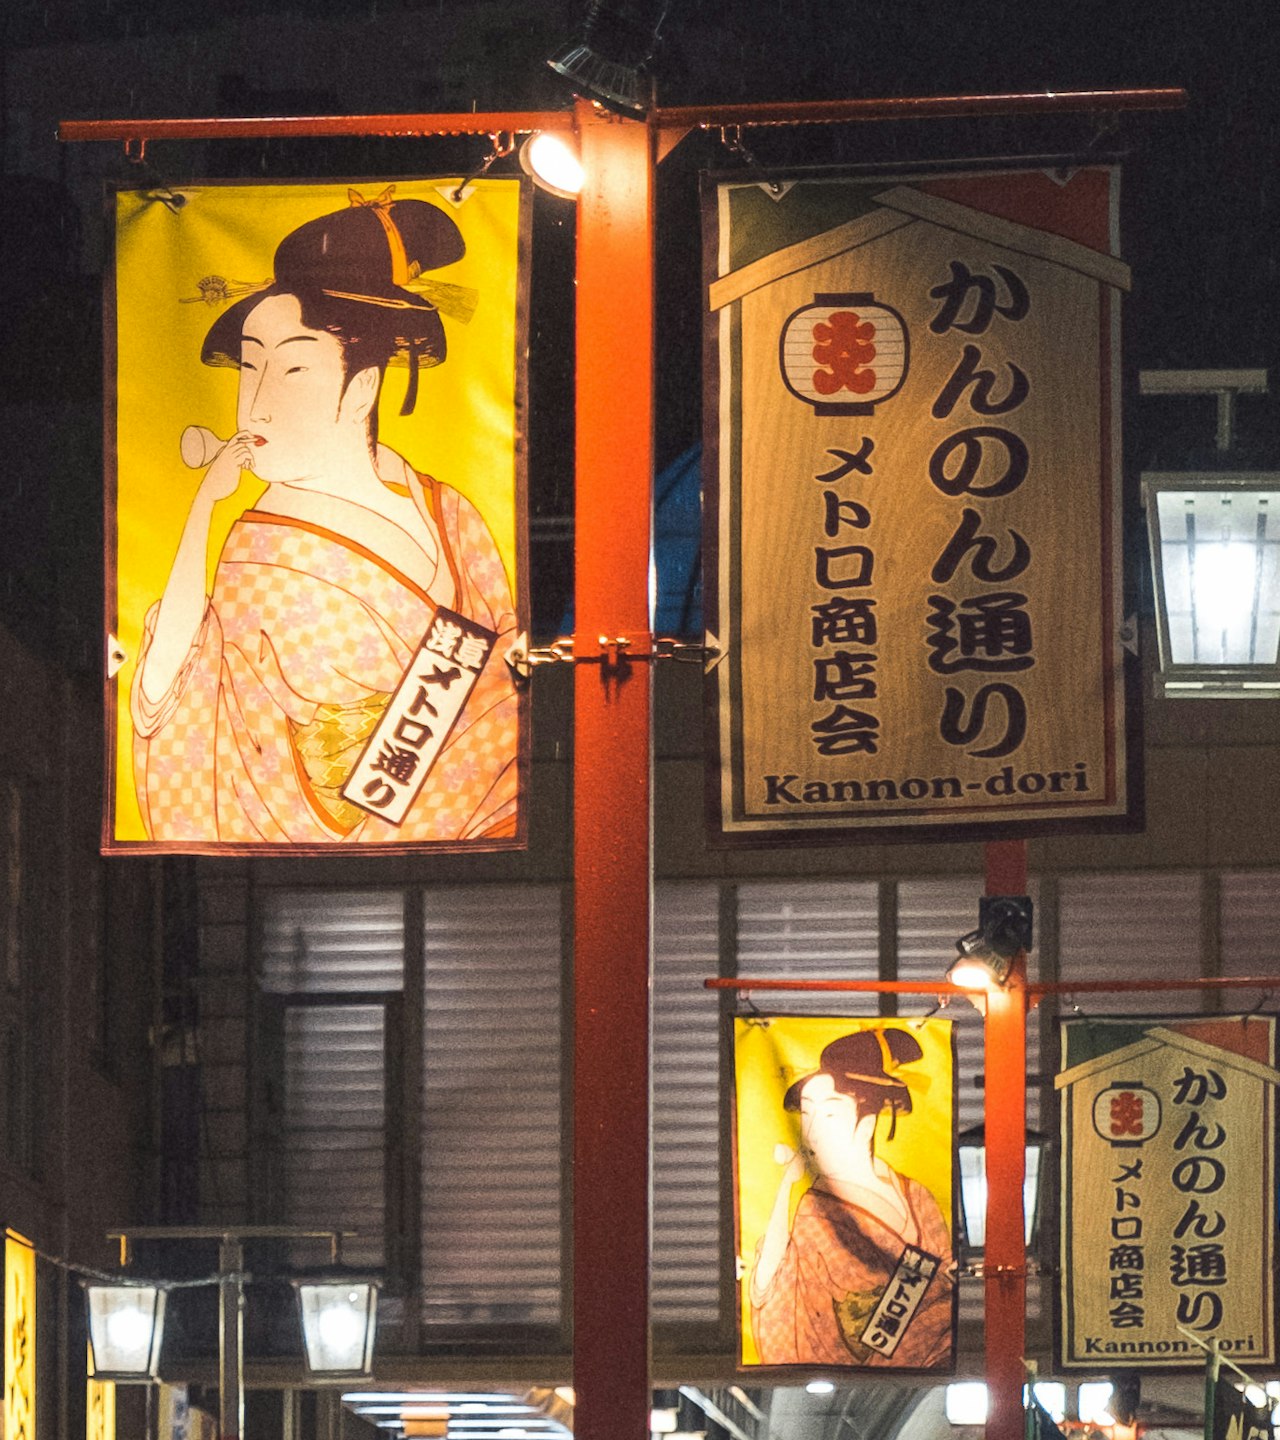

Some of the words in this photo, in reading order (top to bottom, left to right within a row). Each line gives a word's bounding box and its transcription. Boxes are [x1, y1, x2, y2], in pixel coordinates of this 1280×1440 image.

[810, 436, 880, 757] メトロ商店会
[927, 261, 1035, 758] かんのん通り
[362, 662, 462, 809] メトロ通り
[764, 763, 1090, 805] Kannon-dori
[1109, 1159, 1146, 1329] メトロ商店会
[1171, 1066, 1228, 1333] かんのん通り
